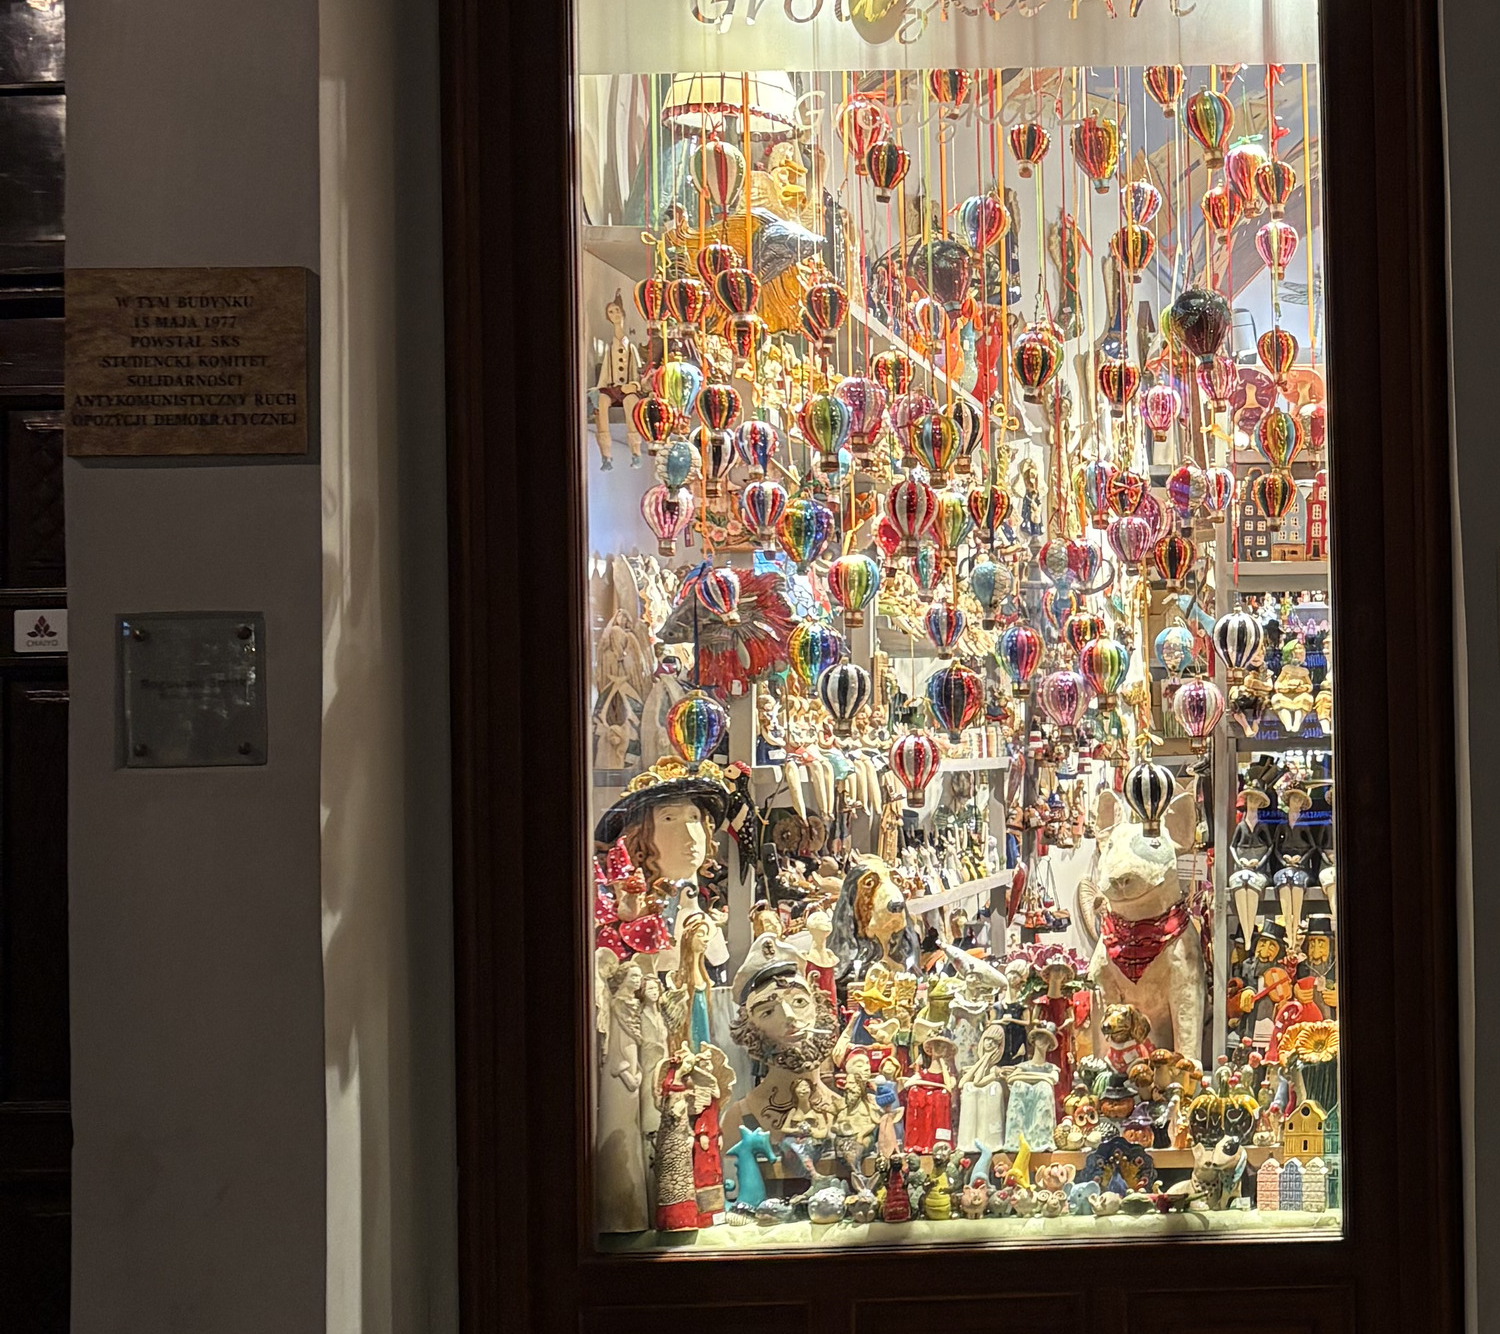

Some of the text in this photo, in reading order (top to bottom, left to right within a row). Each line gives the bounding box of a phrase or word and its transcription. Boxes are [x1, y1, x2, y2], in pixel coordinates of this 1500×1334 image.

[115, 295, 255, 309] W TYM BUDYNKU
[133, 316, 237, 329] 15 MAJA 1977
[211, 335, 240, 348] SKS
[101, 355, 269, 368] STUDENCKI KOMITET
[127, 372, 243, 387] SOLIDARNOŚCI
[74, 393, 297, 408] ANTYKOMUNISTYCZNY RUCH
[154, 413, 297, 427] DEMOKRATYCZNEJ
